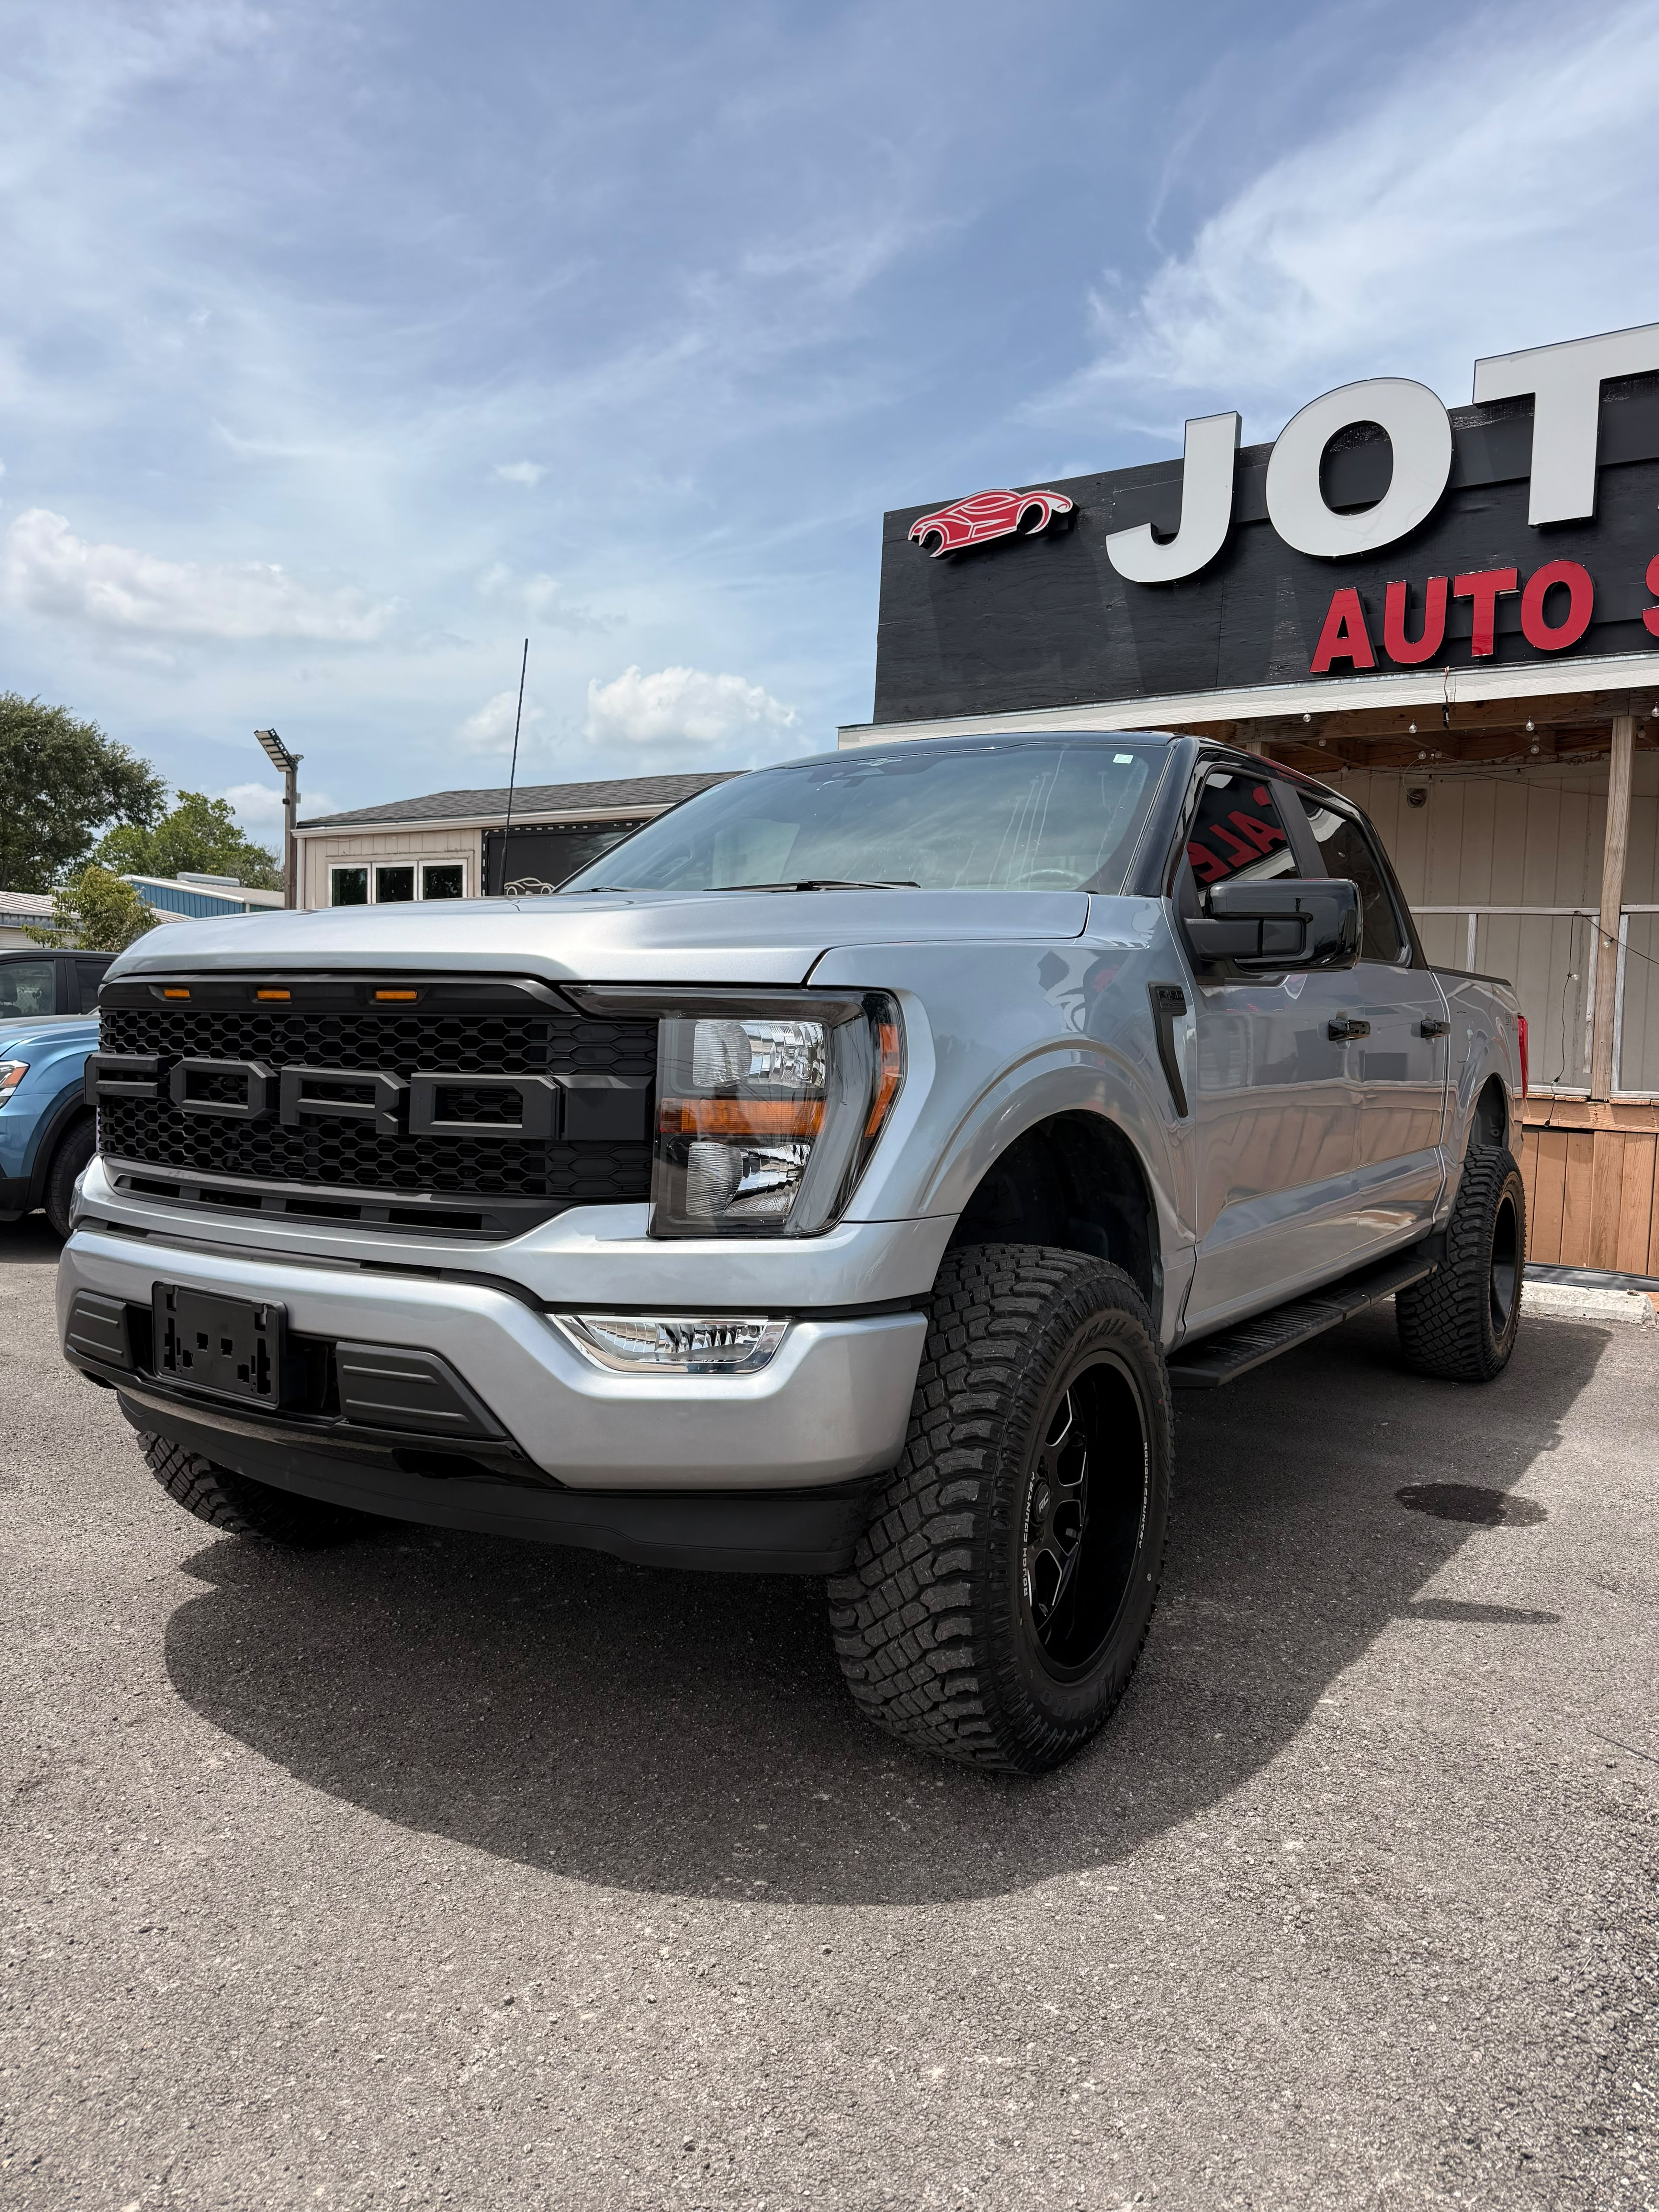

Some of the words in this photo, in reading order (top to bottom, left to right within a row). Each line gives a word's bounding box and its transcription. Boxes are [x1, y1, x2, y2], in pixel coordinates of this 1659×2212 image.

[1106, 323, 1659, 584] JOT
[1309, 559, 1594, 673] AUTO
[84, 1053, 559, 1140] FORD
[1123, 1330, 1167, 1423] BLADE
[1023, 1471, 1035, 1543] COUNTRY
[1039, 1491, 1049, 1514] RC
[1138, 1487, 1148, 1549] COUNTRY
